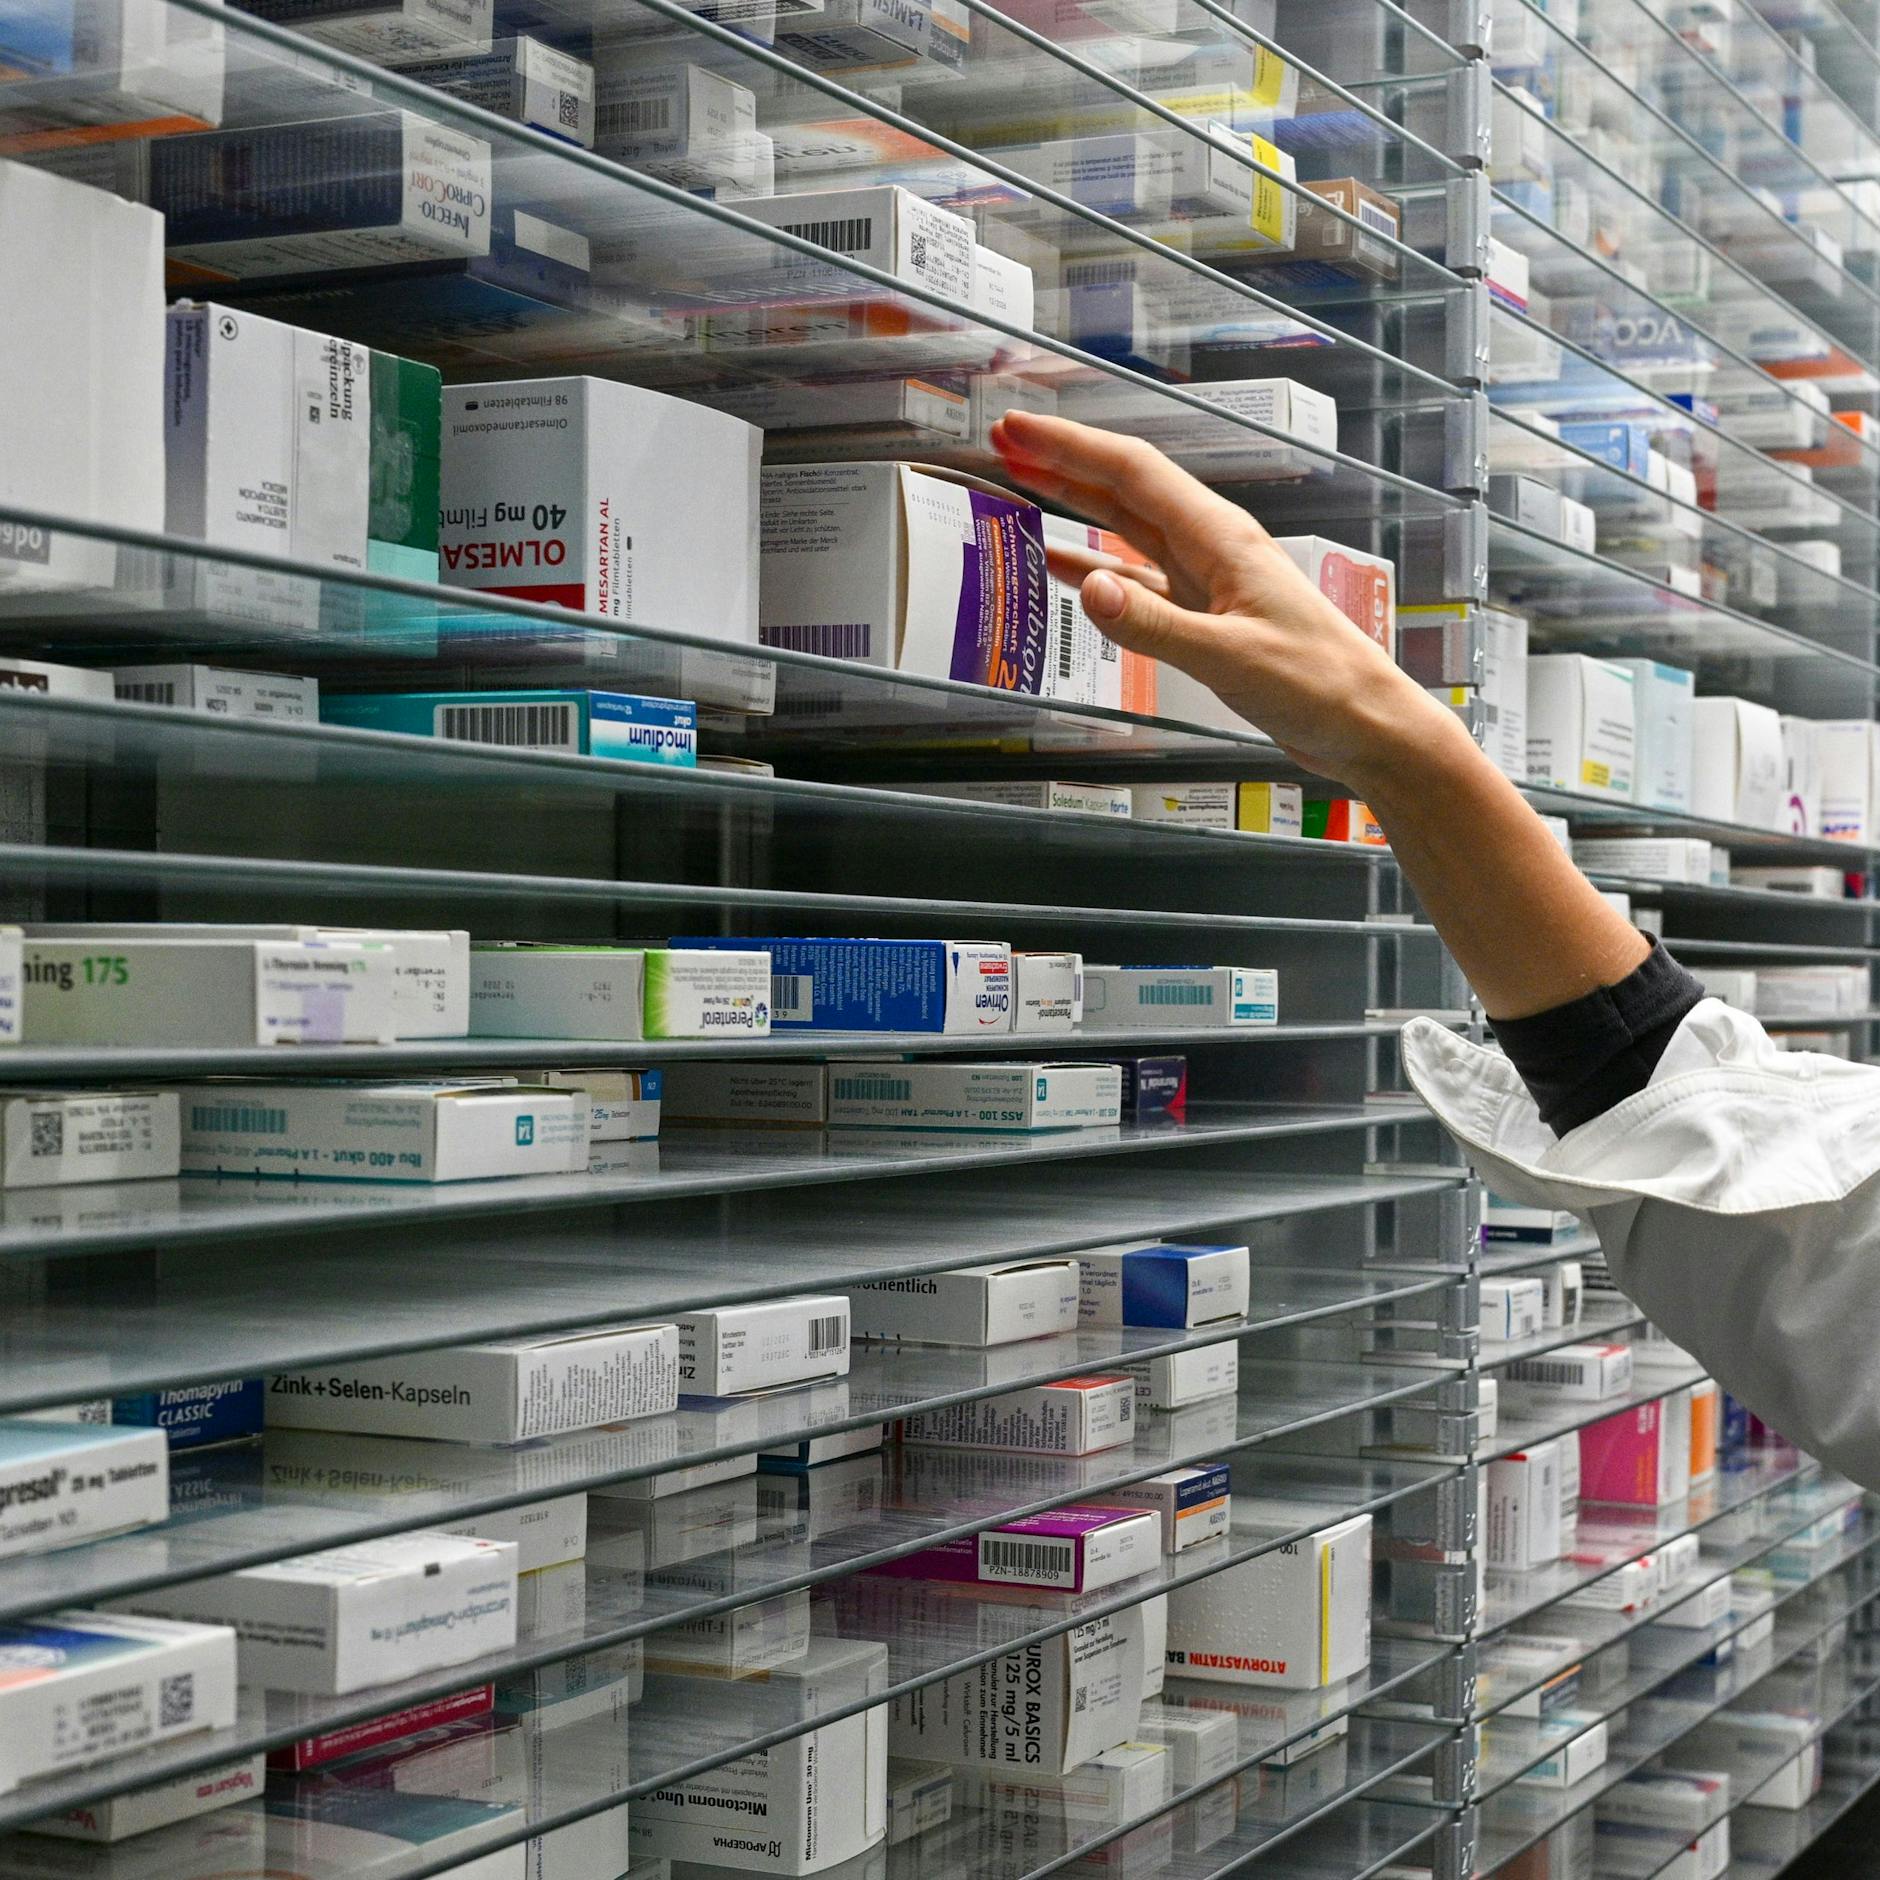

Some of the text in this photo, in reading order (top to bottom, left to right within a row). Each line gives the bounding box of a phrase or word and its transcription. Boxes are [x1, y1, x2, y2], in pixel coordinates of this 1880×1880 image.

[872, 0, 923, 31] LAMISI
[484, 395, 568, 410] 98 Filmtabletten
[453, 418, 567, 436] Olmesartanmedoxomil
[439, 502, 567, 530] 40 mg Filmt
[1000, 517, 1006, 527] ab
[980, 520, 988, 550] Energie
[986, 522, 994, 549] Gehirn
[993, 525, 1002, 565] Folsäure
[600, 497, 609, 617] MESARTAN AL
[612, 517, 621, 616] mg Filmtabletten
[975, 519, 985, 648] Weitere ausgewählte Nährstoffe
[996, 595, 1004, 614] und
[997, 514, 1019, 690] Schwangerschaft 2
[1015, 511, 1045, 694] femibion
[994, 617, 1003, 647] Cholin
[1002, 622, 1010, 652] Geburt
[629, 727, 692, 753] Imodium
[1053, 792, 1083, 808] Soledum
[1110, 799, 1128, 814] forte
[22, 954, 129, 991] ning 175
[975, 994, 1008, 1012] Otriven
[1037, 1008, 1071, 1020] Paracetamol-
[702, 1011, 753, 1028] Perenterol
[901, 1108, 917, 1116] TAH
[980, 1110, 997, 1120] 100
[1001, 1110, 1024, 1121] ASS
[334, 1151, 365, 1164] akut
[370, 1152, 396, 1166] 400
[399, 1154, 422, 1167] Ibu
[852, 1277, 937, 1295] chentlich
[270, 1374, 471, 1407] Zink+Selen-Kapseln
[157, 1402, 214, 1427] CLASSIC
[989, 1564, 1060, 1581] PZN-18878909
[1189, 1652, 1286, 1674] ATORVASTATIN
[1001, 1655, 1020, 1762] 125 mg/5 ml
[1026, 1642, 1041, 1763] UROX BASICS
[988, 1710, 998, 1759] Herstellung
[808, 1747, 814, 1762] mg
[807, 1765, 812, 1777] 30
[688, 1794, 767, 1816] Mictonorm
[713, 1837, 766, 1852] APOGEPHA
